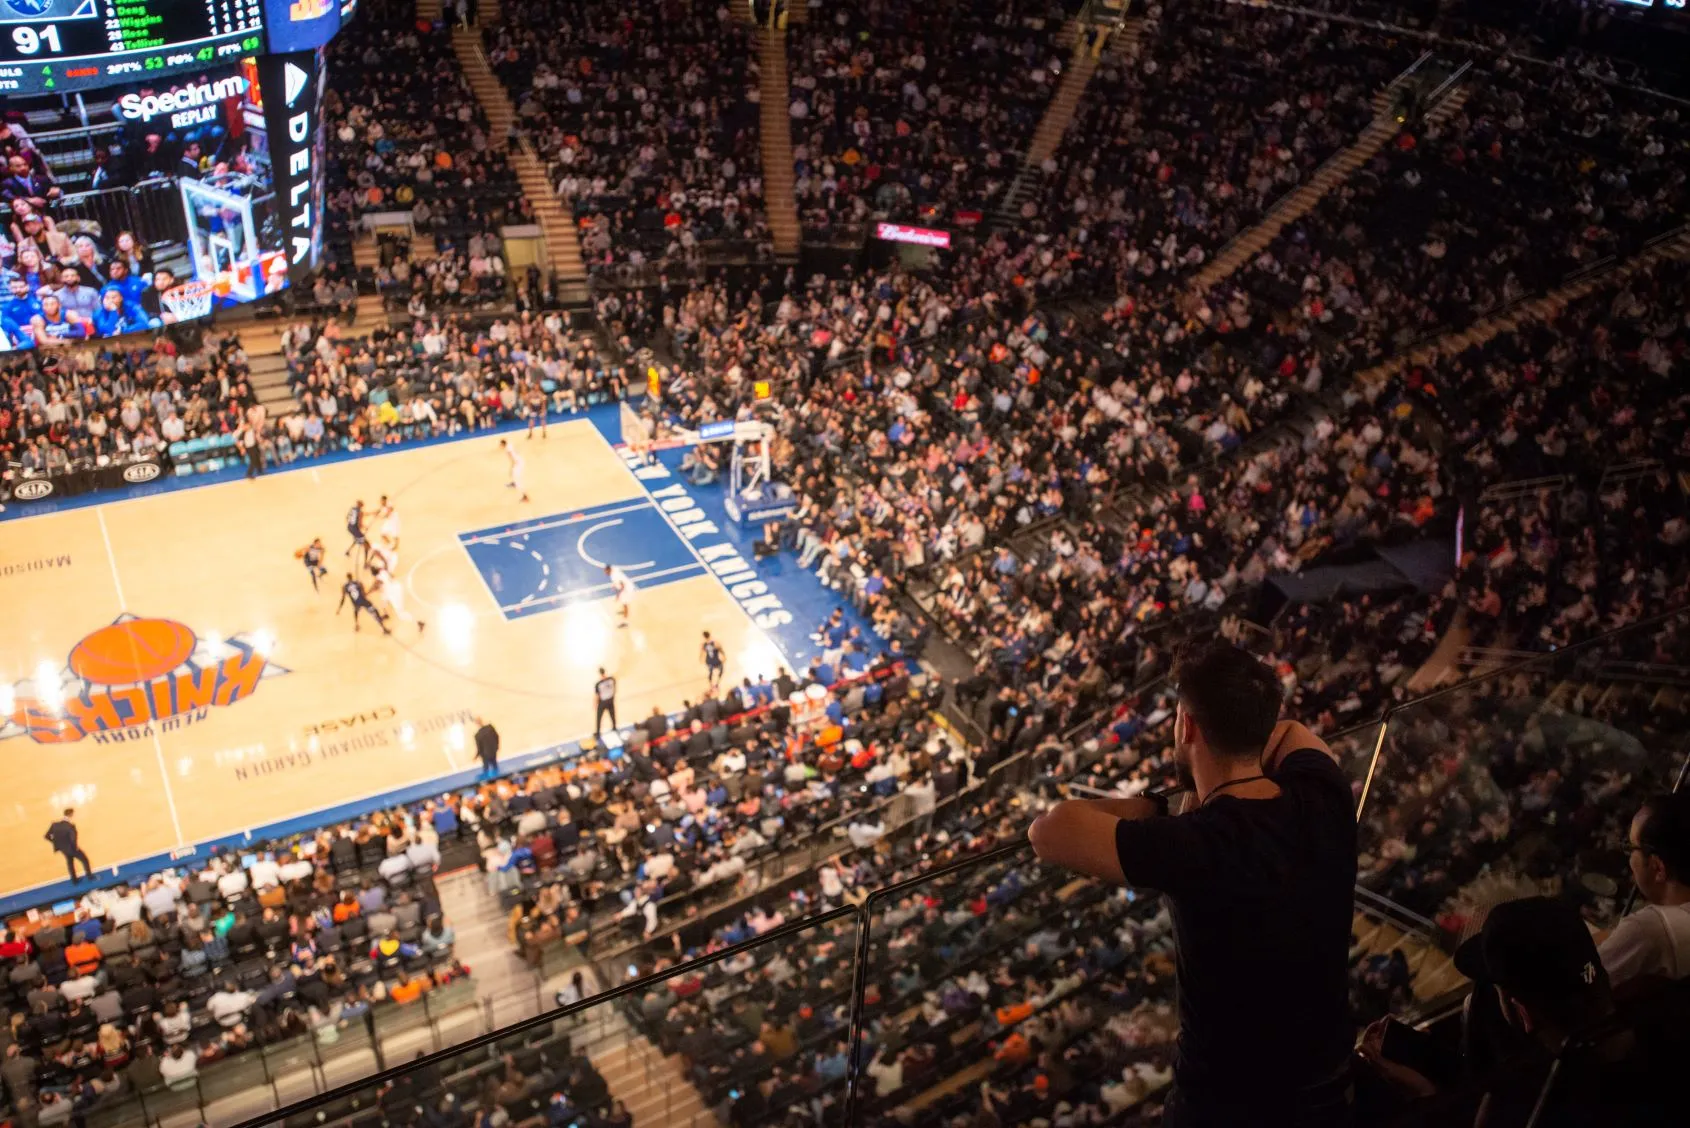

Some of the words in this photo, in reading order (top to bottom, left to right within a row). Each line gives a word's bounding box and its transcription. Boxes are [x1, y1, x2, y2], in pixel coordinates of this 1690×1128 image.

[120, 15, 163, 27] Wiggins
[12, 24, 61, 54] 91
[144, 56, 164, 71] 53
[196, 46, 215, 61] 47
[121, 75, 244, 122] Spectrum
[171, 105, 217, 129] REPLAY
[289, 111, 311, 265] DELTA
[652, 483, 720, 540] YORK
[698, 542, 793, 629] KNICKS
[9, 648, 268, 744] KNICKS
[92, 723, 155, 744] YORK
[303, 705, 397, 736] CHASE
